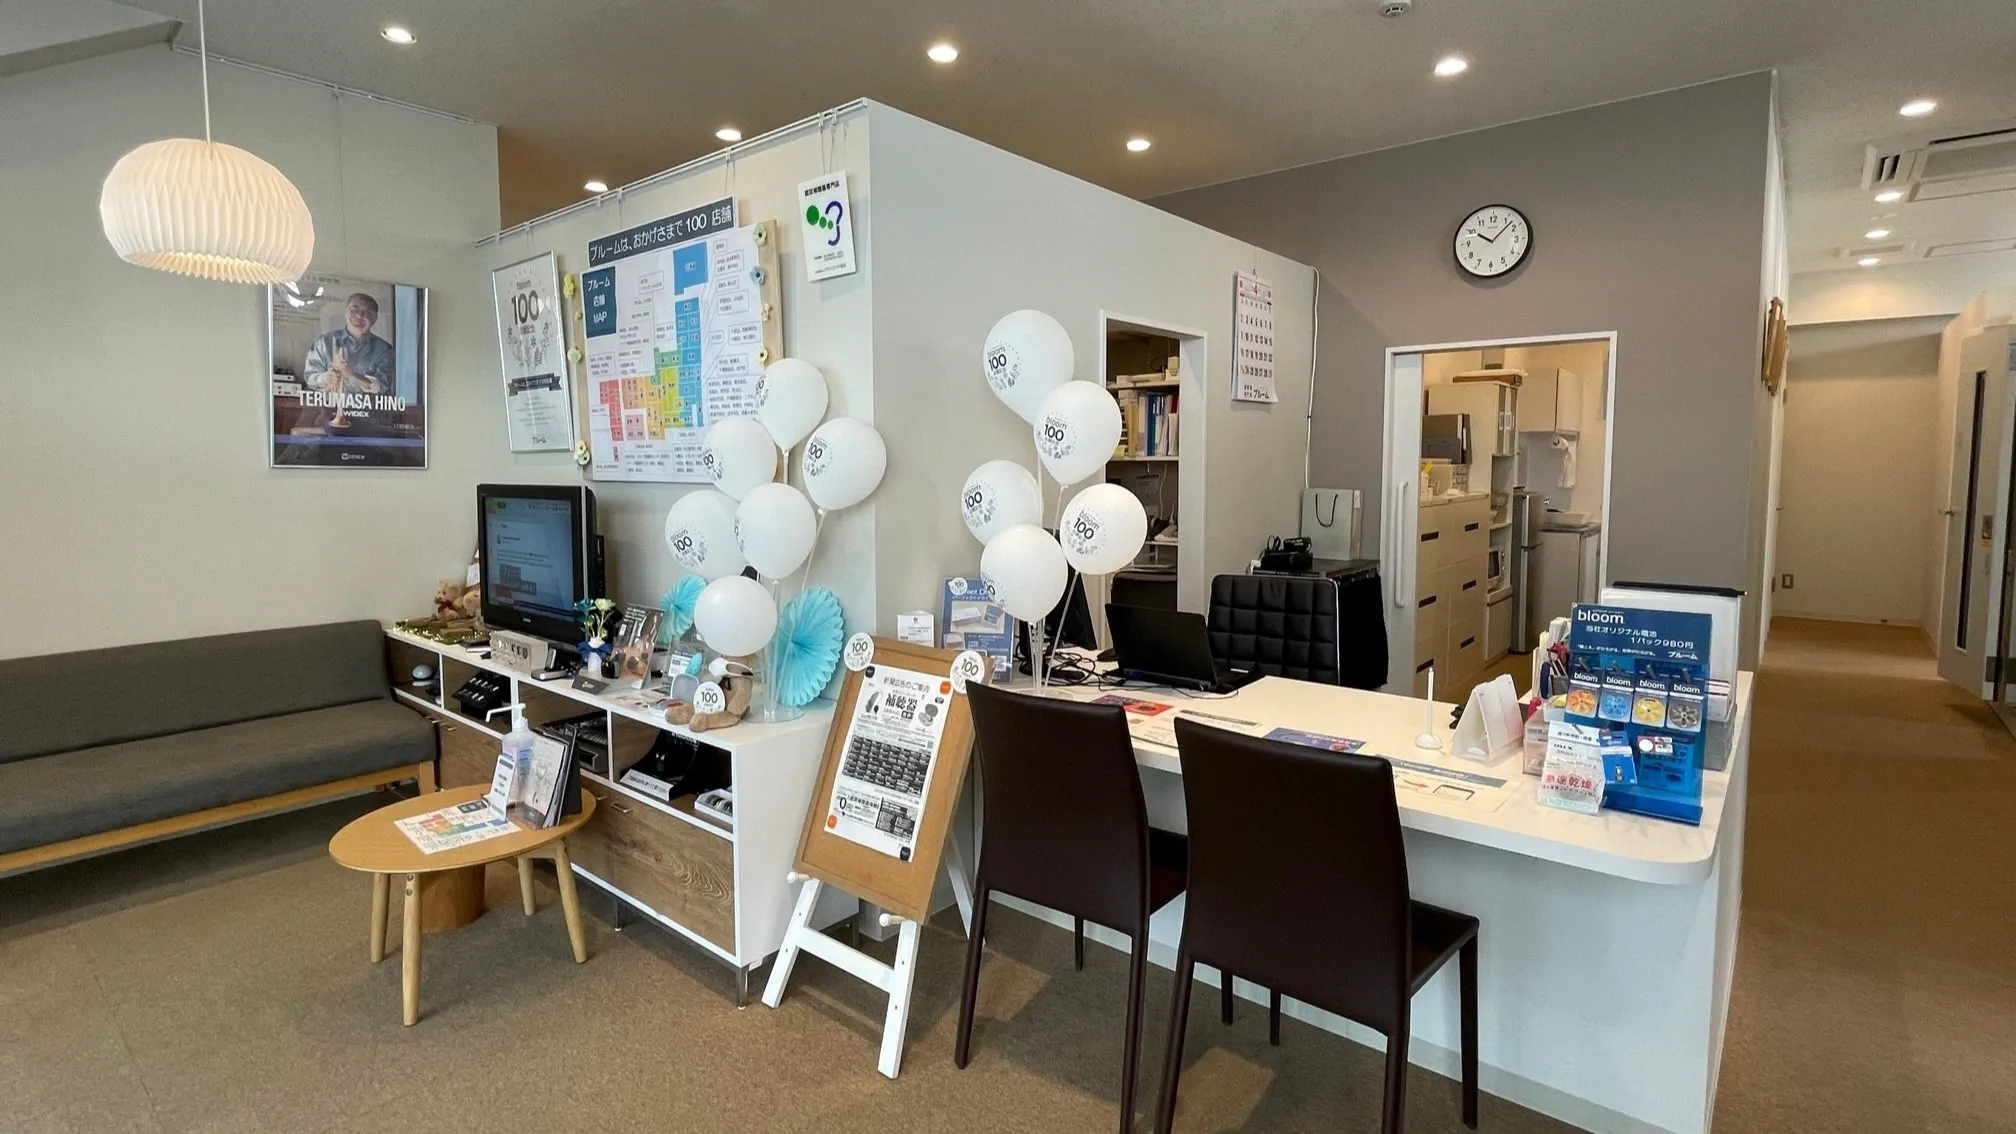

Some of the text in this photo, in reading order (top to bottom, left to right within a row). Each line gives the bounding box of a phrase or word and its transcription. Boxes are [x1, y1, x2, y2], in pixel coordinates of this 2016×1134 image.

[1490, 215, 1498, 223] 12
[590, 205, 732, 261] ブルームは、おかげさまで 100 店舗
[1511, 224, 1517, 232] 2
[1466, 240, 1471, 248] 9
[1514, 235, 1519, 243] 3
[1469, 251, 1474, 259] 8
[1510, 247, 1515, 255] 4
[1500, 256, 1506, 264] 5
[587, 278, 611, 292] ブルーム
[511, 290, 540, 325] 100
[988, 353, 1007, 371] 100
[299, 390, 406, 411] TERUMASA HINO
[342, 410, 369, 418] WIDEX
[1045, 424, 1064, 441] 100
[808, 442, 823, 459] 100
[965, 491, 982, 510] 100
[1079, 509, 1100, 531] bloom
[1073, 517, 1094, 540] 100
[673, 536, 693, 553] 100
[1577, 609, 1624, 624] bloom
[1585, 625, 1657, 637] 当社オリジナル電池
[852, 641, 868, 653] 100
[1631, 637, 1694, 649] 1パック980円
[1667, 651, 1698, 660] ブルーム
[961, 658, 979, 676] 100
[1573, 672, 1598, 683] bloom
[1606, 676, 1631, 687] bloom
[1639, 680, 1666, 690] bloom
[1673, 684, 1700, 694] bloom
[701, 691, 718, 704] 100
